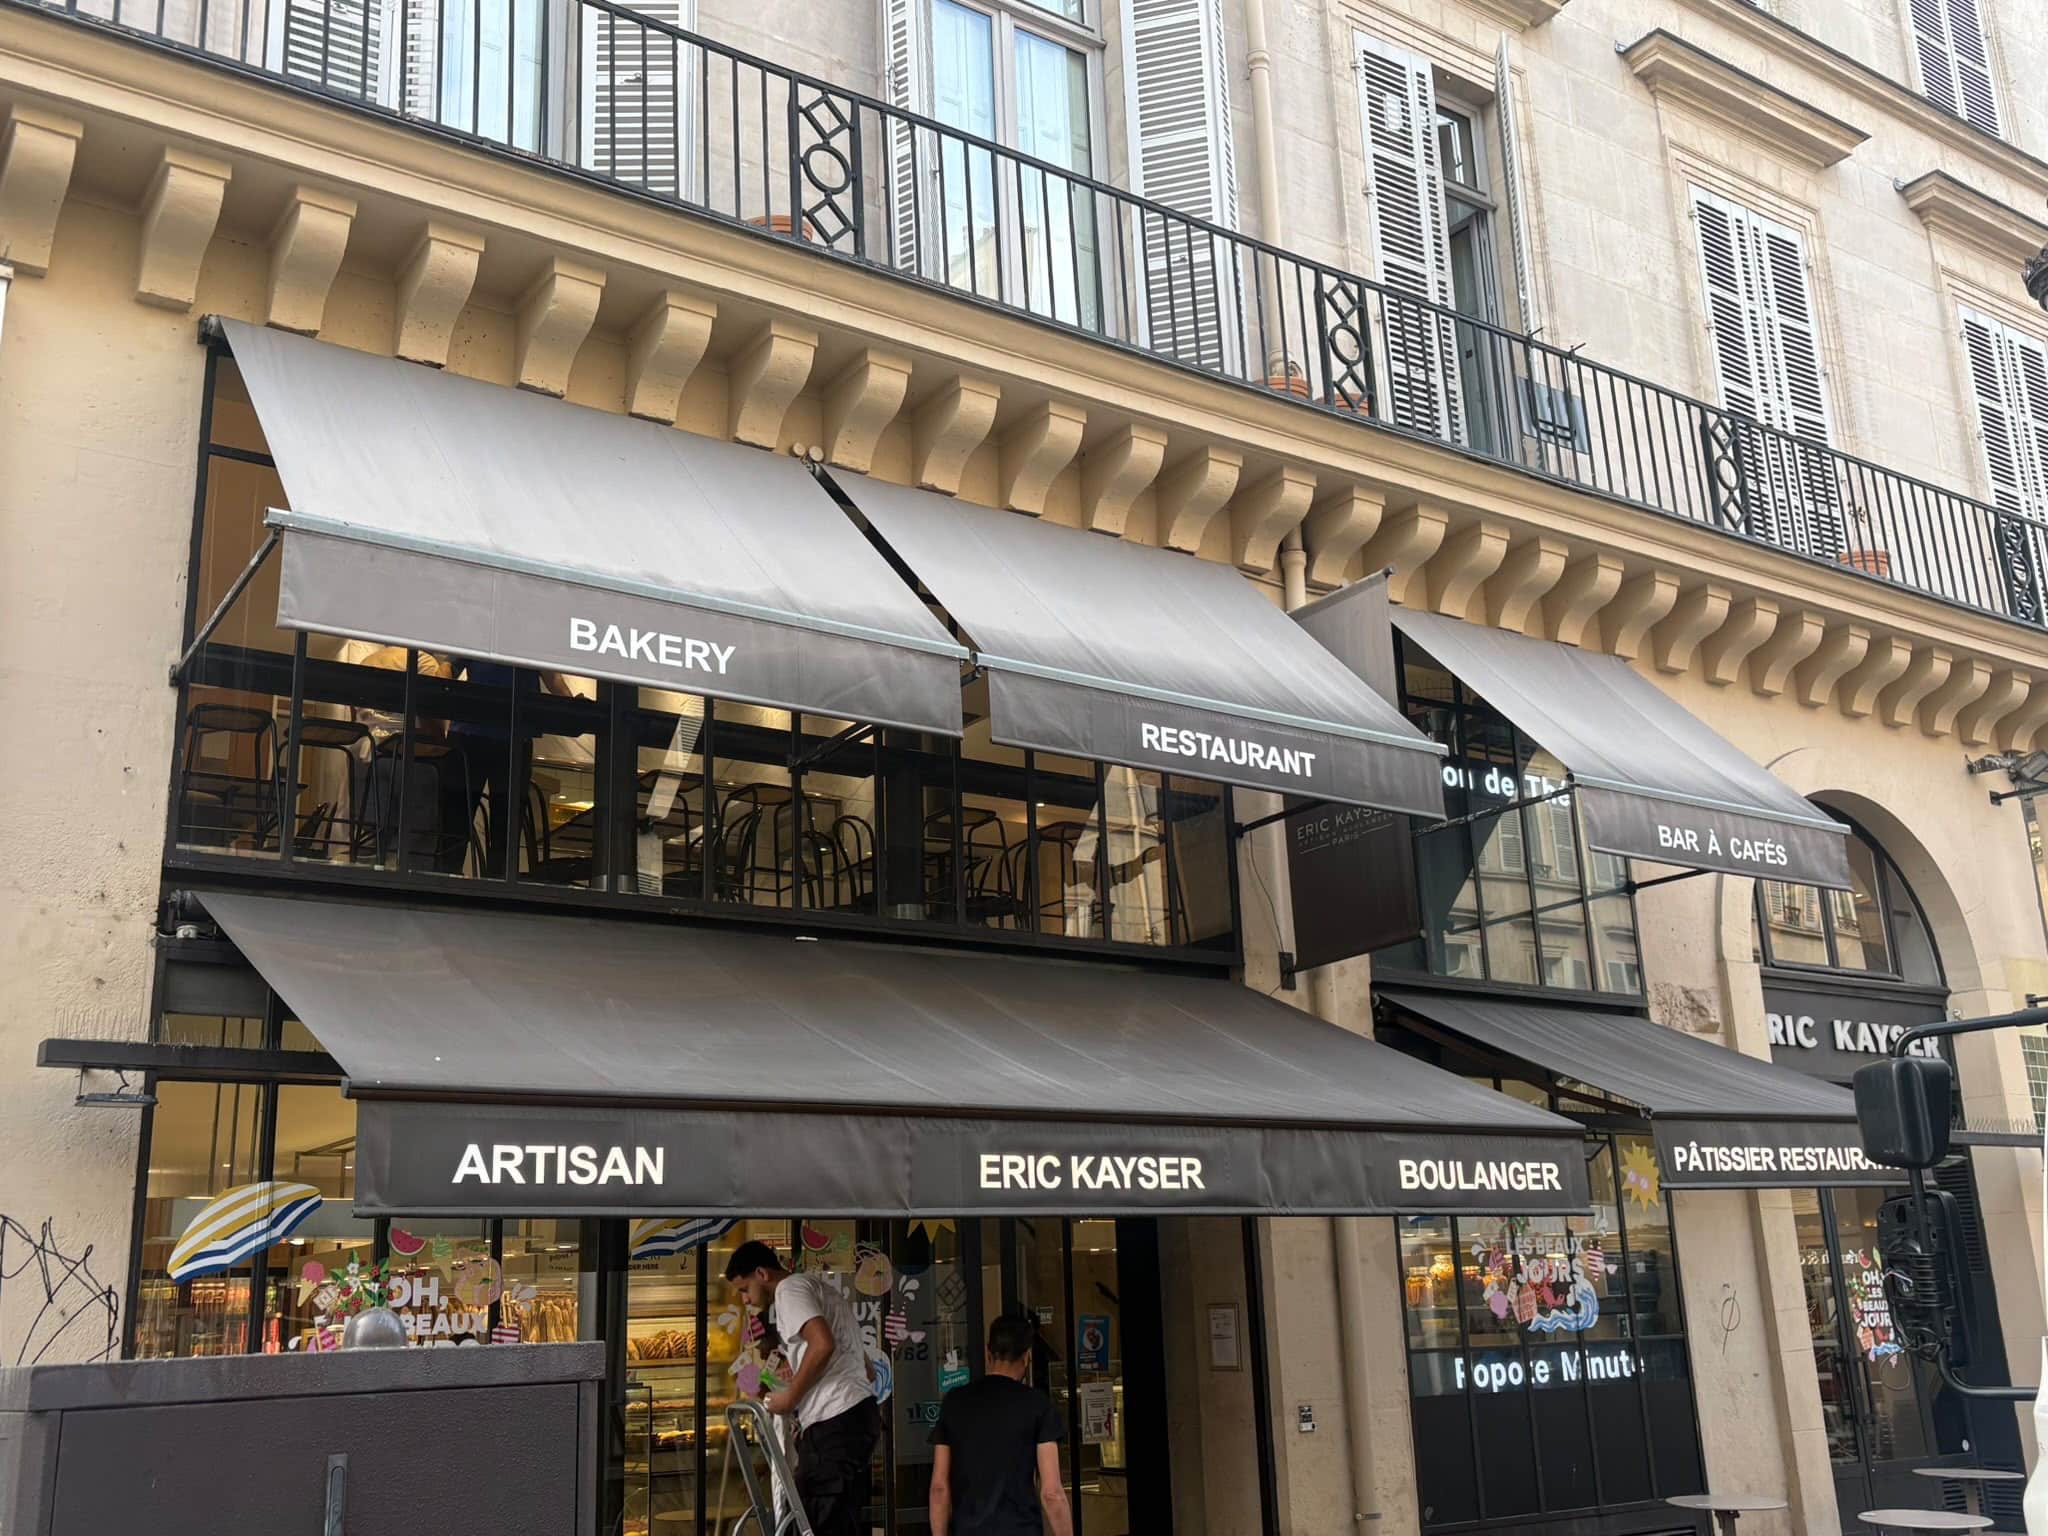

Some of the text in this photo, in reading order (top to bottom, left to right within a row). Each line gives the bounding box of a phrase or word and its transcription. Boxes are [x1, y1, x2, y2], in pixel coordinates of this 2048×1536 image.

[570, 617, 736, 675] BAKERY
[1141, 723, 1316, 777] RESTAURANT
[1485, 767, 1515, 797] de
[1297, 818, 1329, 840] ERIC
[1335, 808, 1392, 827] KAYS
[1658, 825, 1788, 866] BAR À CAFÉS
[1766, 1012, 1818, 1049] RIC
[452, 1143, 664, 1185] ARTISAN
[980, 1154, 1205, 1190] ERIC KAYSER
[1673, 1141, 1776, 1172] PÂTISSIER
[1399, 1159, 1563, 1191] BOULANGER
[1506, 1237, 1583, 1255] LES BEAUX
[1517, 1258, 1585, 1283] JOURS
[389, 1276, 449, 1310] OH,
[401, 1312, 488, 1336] BEAUX
[1861, 1312, 1893, 1327] JOUR
